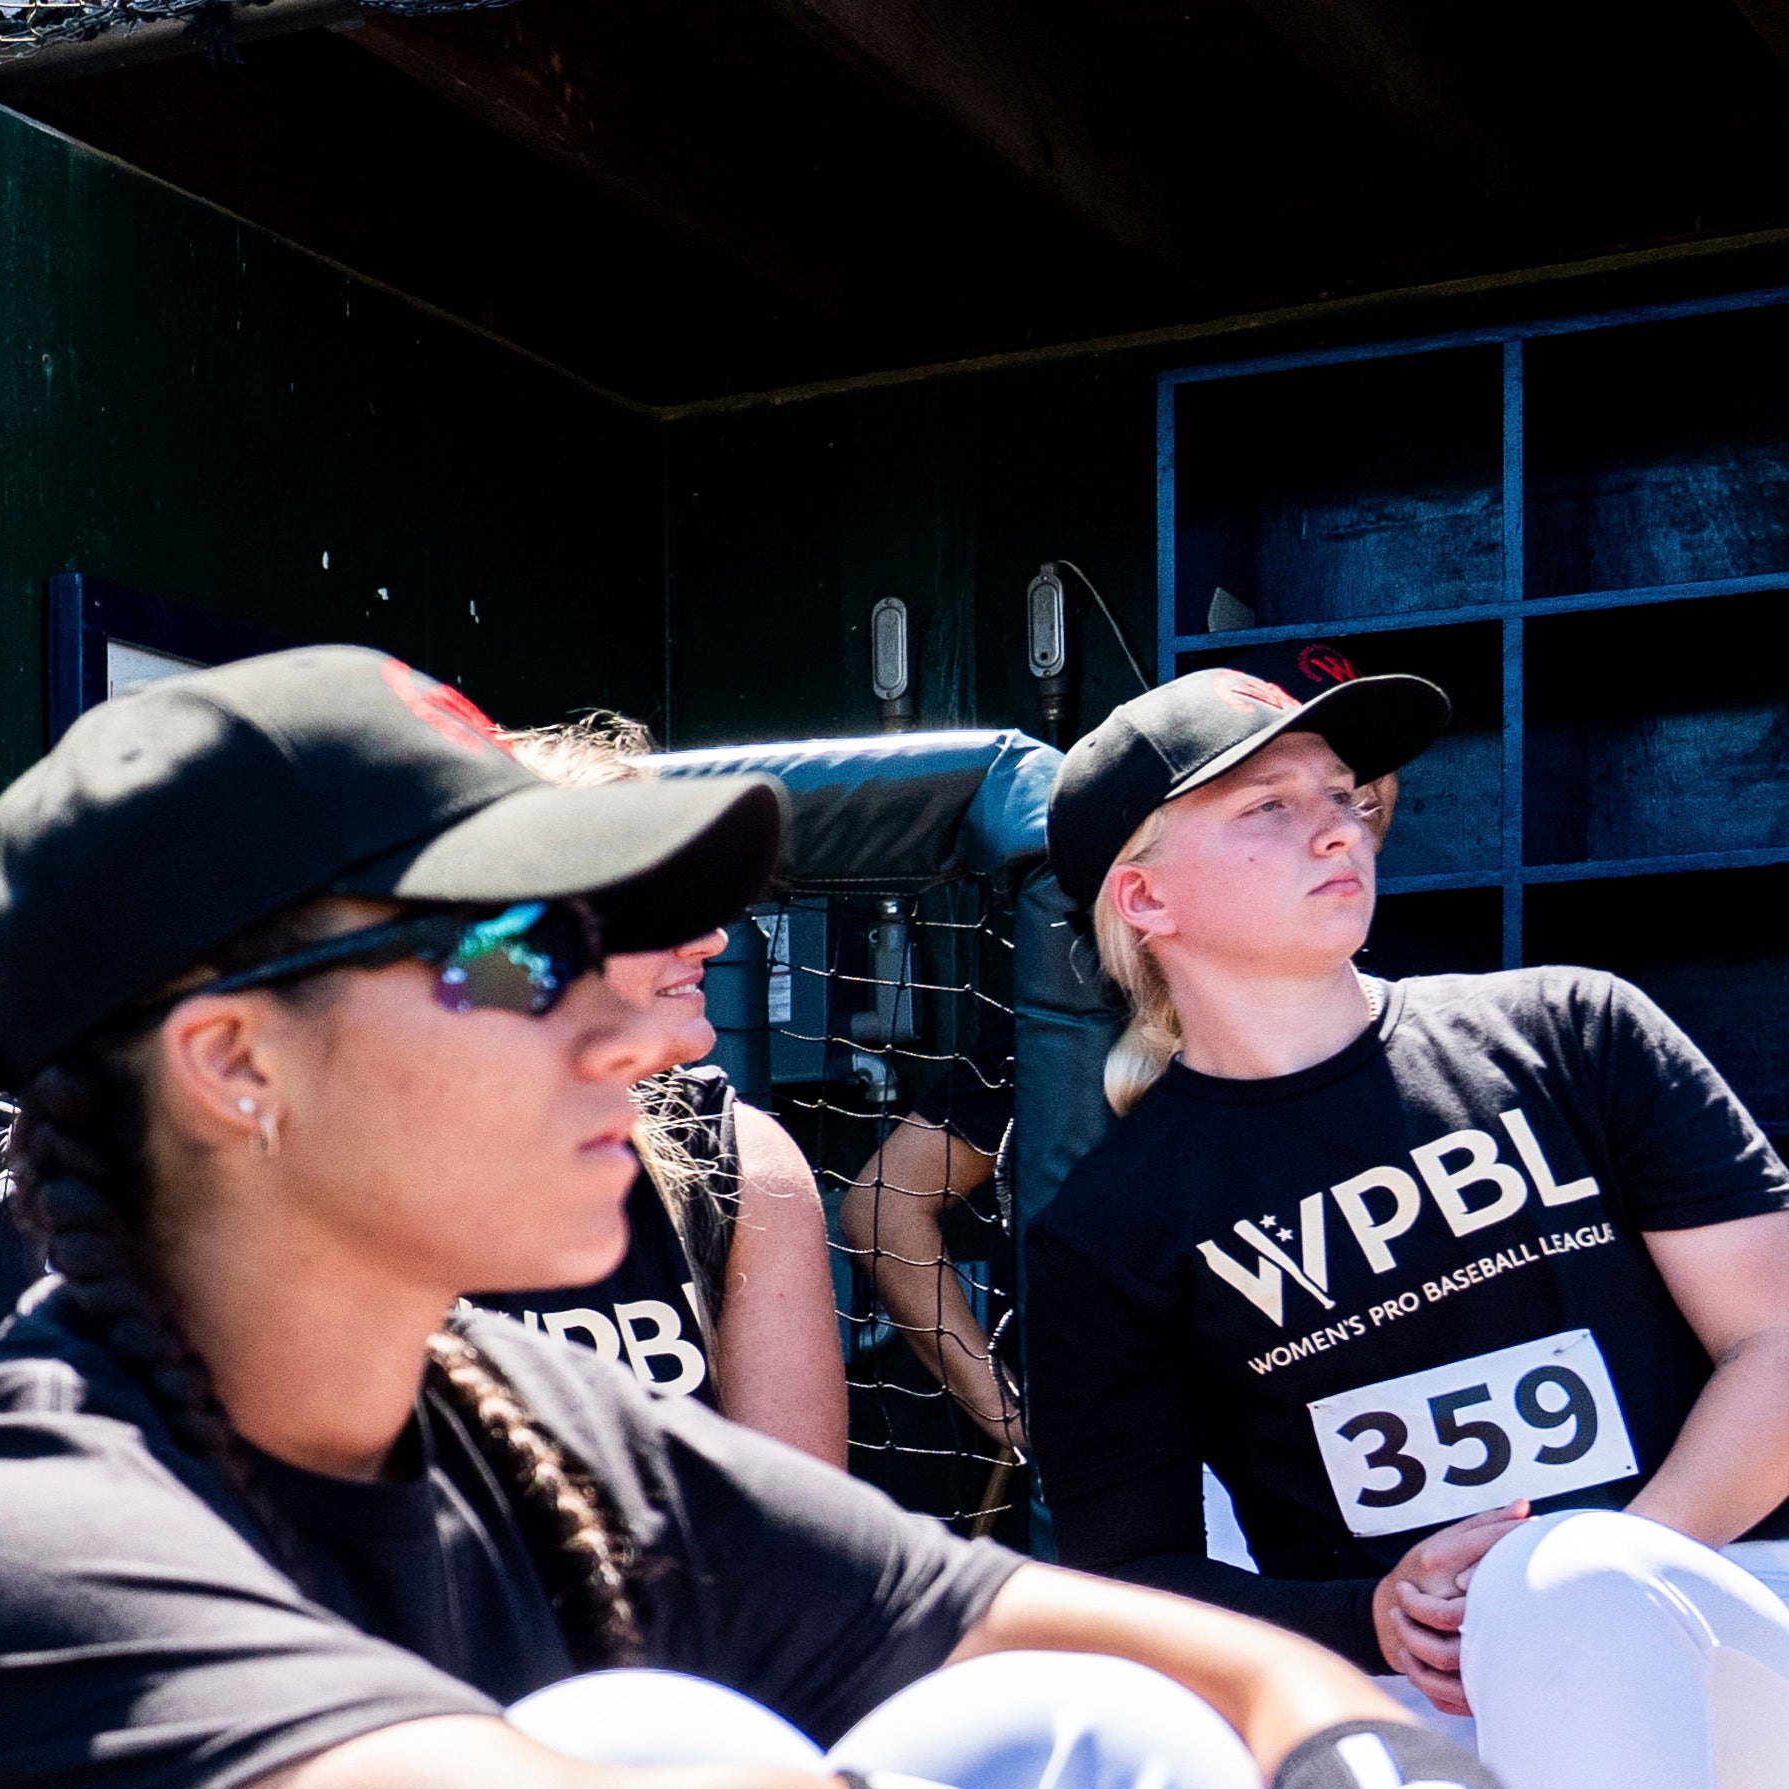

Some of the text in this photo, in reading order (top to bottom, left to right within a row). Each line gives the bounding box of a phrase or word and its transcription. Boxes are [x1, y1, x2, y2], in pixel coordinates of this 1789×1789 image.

[1196, 1107, 1600, 1327] WPBL
[1248, 1316, 1365, 1376] WOMEN'S
[1369, 1292, 1420, 1328] PRO
[1422, 1243, 1540, 1303] BASEBALL
[1334, 1364, 1600, 1509] 359
